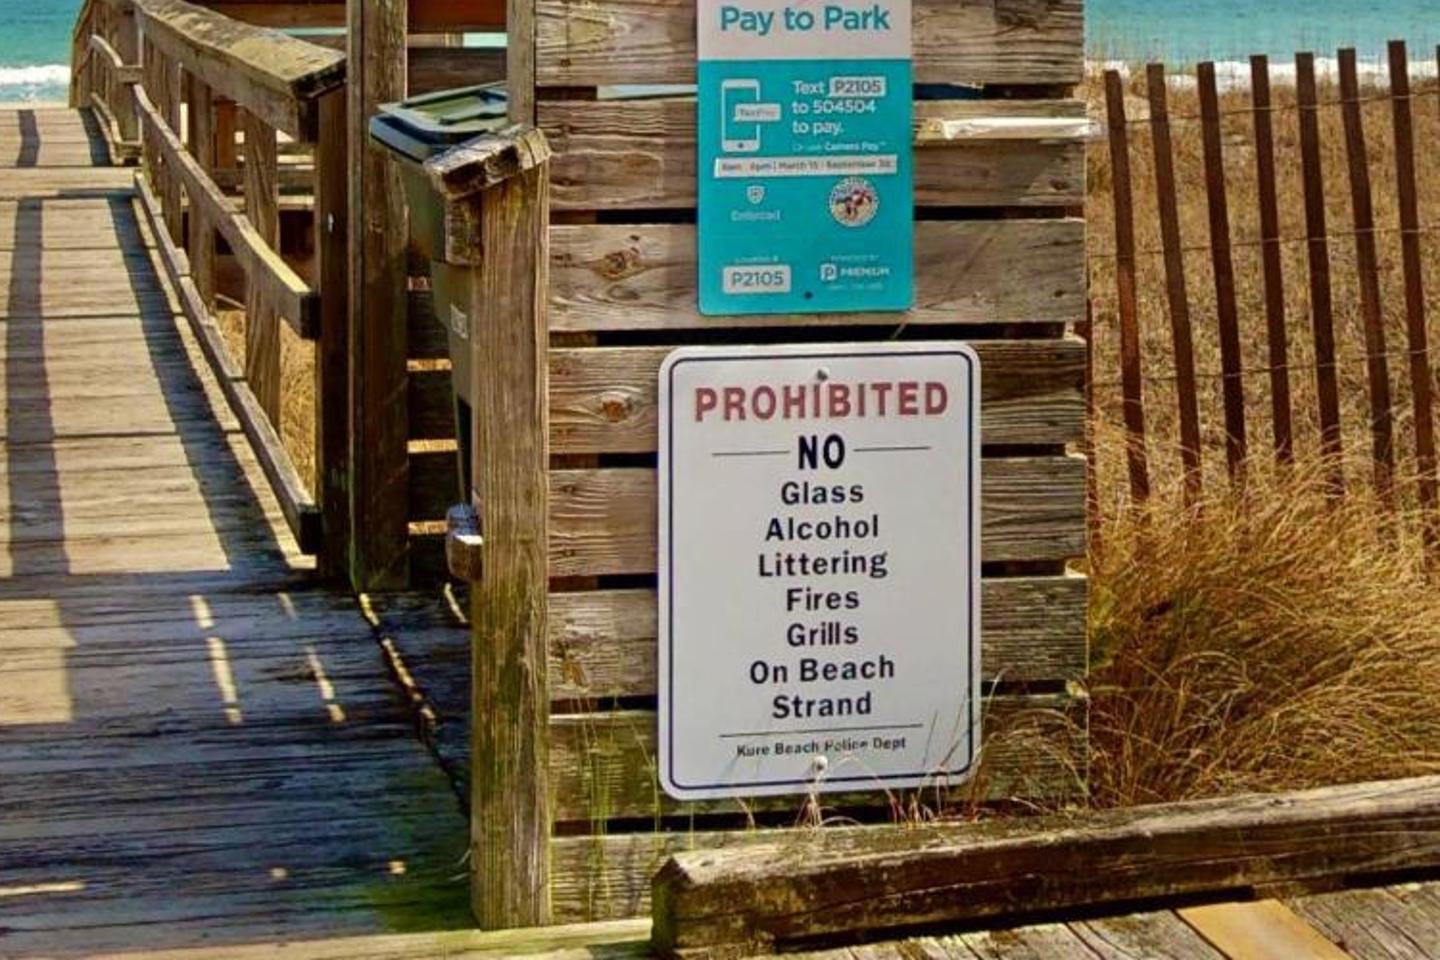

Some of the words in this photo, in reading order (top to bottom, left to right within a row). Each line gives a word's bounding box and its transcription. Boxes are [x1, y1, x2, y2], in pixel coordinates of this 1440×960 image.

[720, 6, 774, 35] Pay
[784, 8, 814, 31] to
[824, 4, 890, 31] Park
[793, 80, 824, 95] Text
[834, 80, 882, 93] P2105
[792, 102, 808, 114] to
[813, 100, 876, 114] 504504
[792, 121, 808, 133] to
[813, 123, 843, 136] pay.
[731, 271, 784, 286] P2105
[694, 381, 948, 422] PROHIBITED
[798, 434, 846, 470] NO
[780, 480, 864, 506] Glass
[765, 515, 879, 541] Alcohol
[759, 551, 888, 578] Littering
[786, 587, 860, 612] Fires
[787, 623, 859, 647] Grills
[750, 660, 788, 685] On
[800, 655, 895, 682] Beach
[772, 692, 872, 719] Strand
[737, 744, 770, 757] Kure
[774, 741, 819, 755] Beach
[872, 736, 906, 750] Dept
